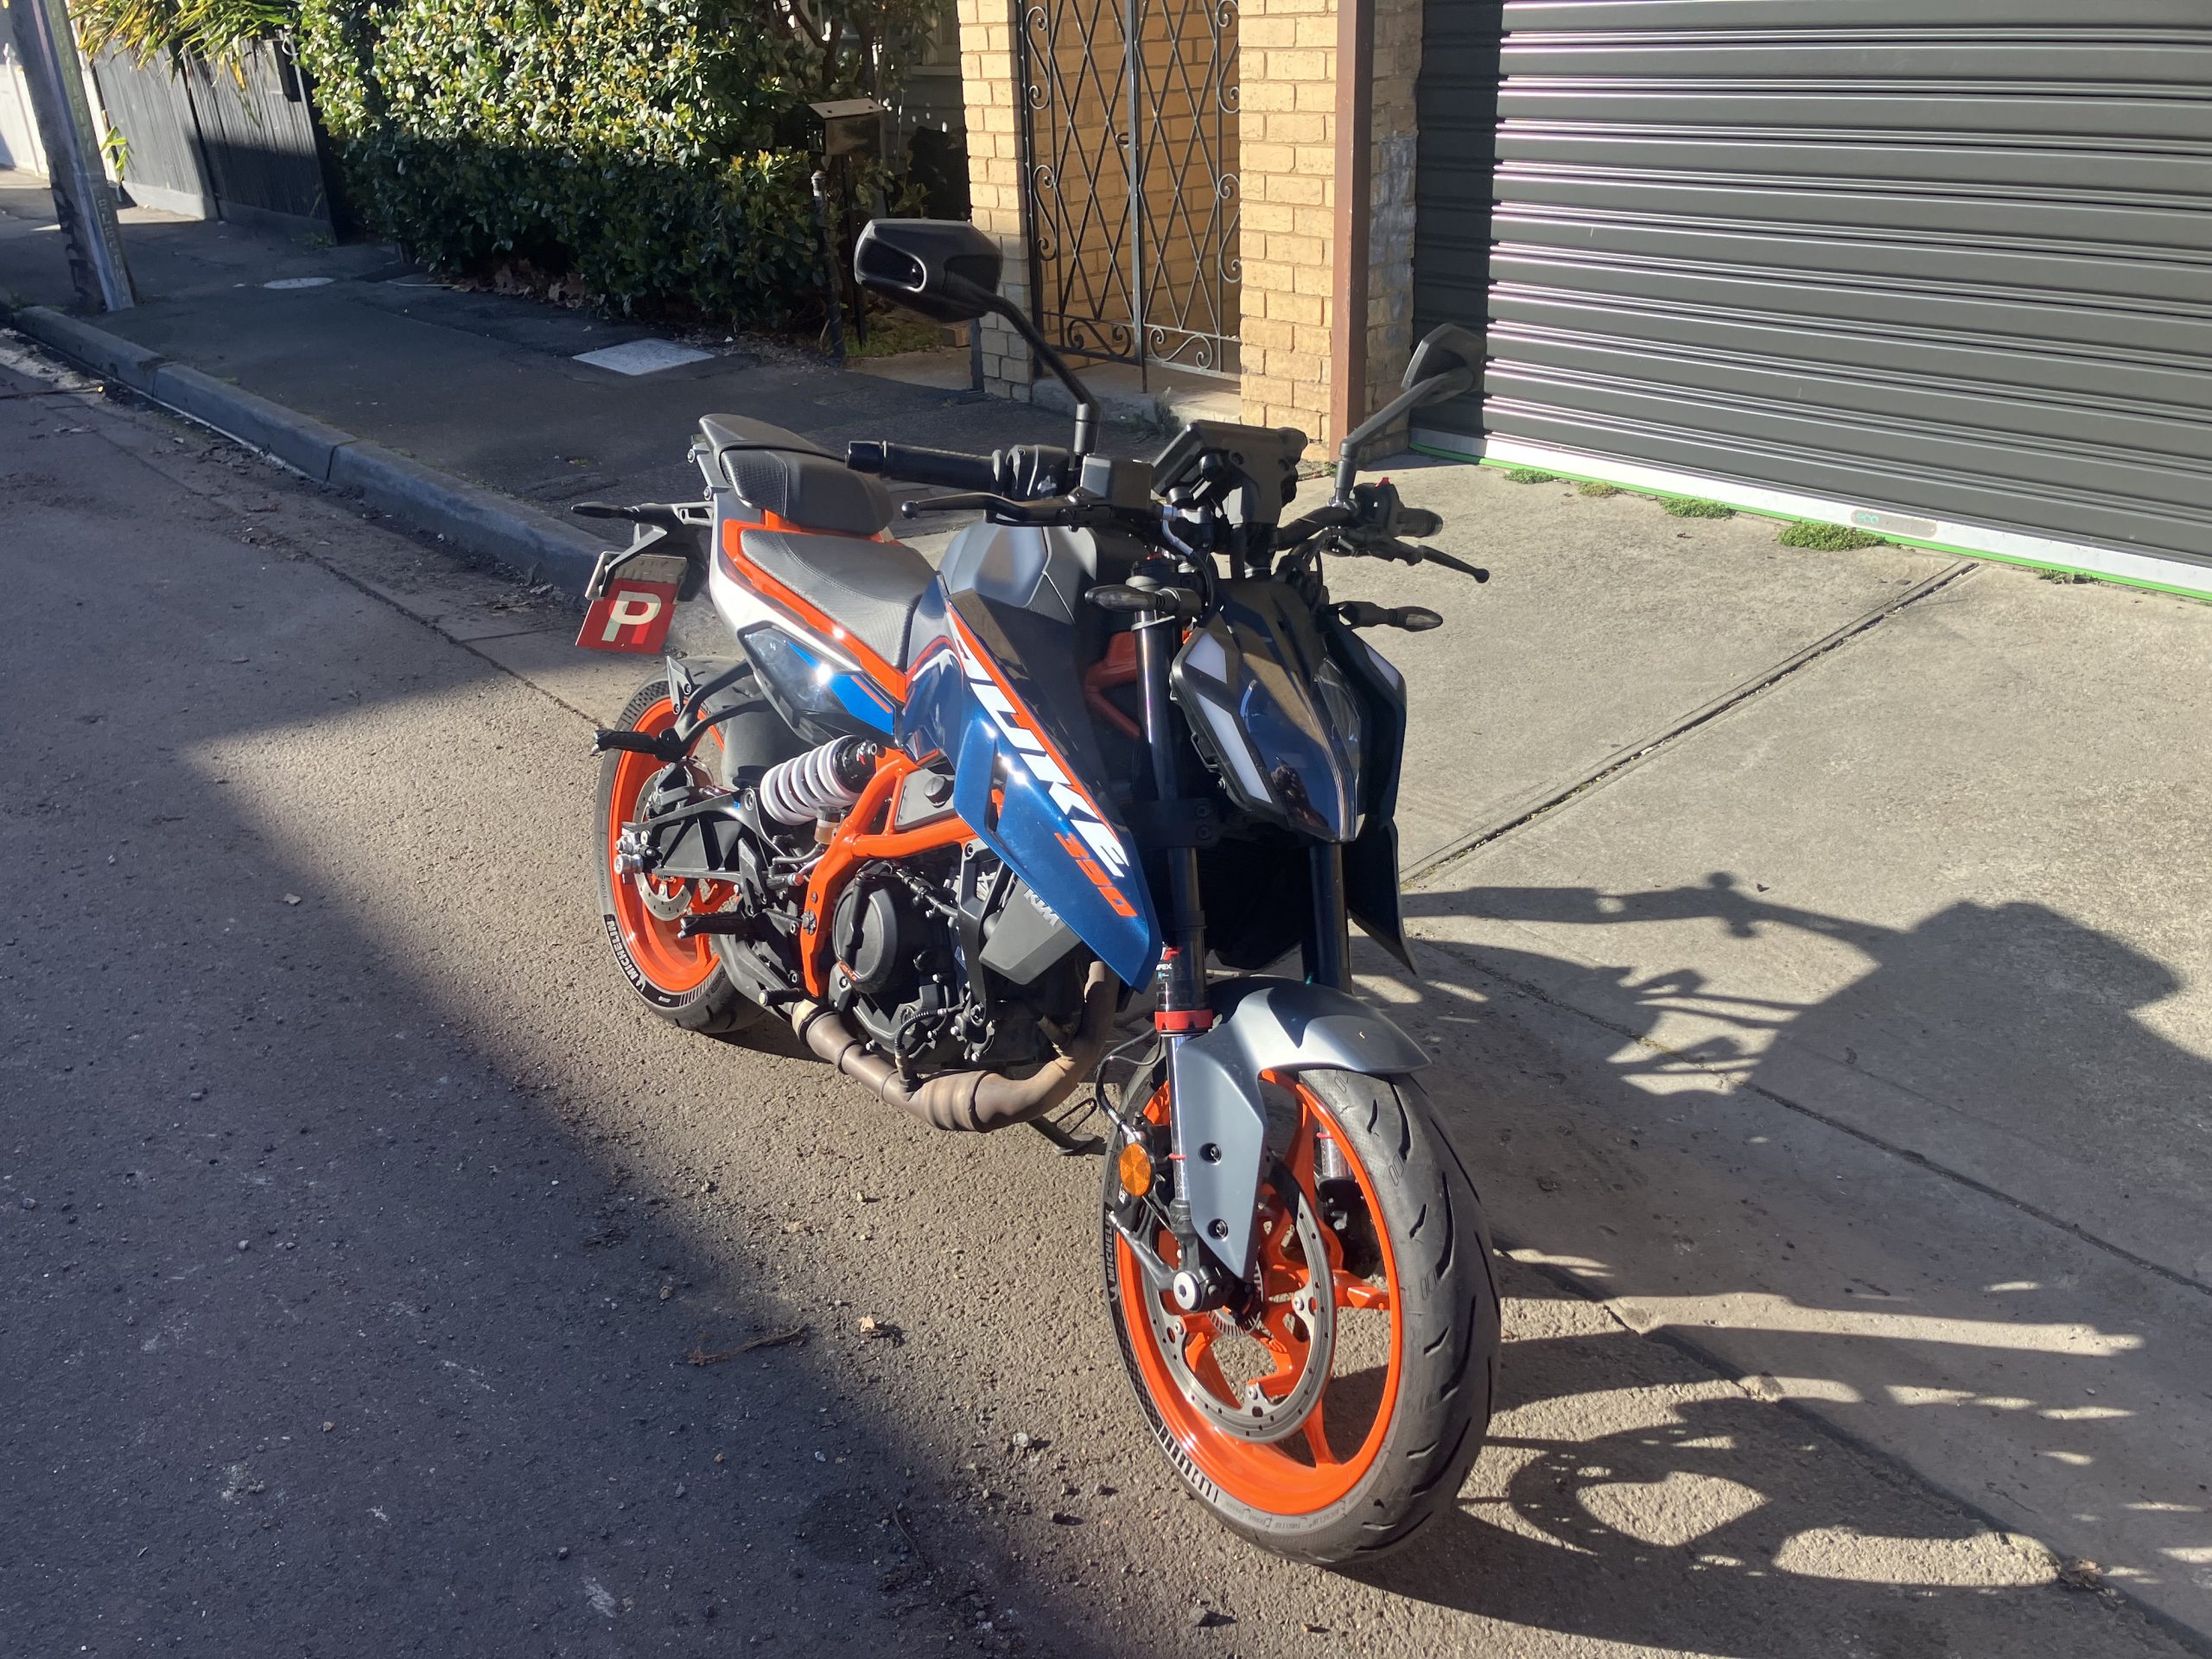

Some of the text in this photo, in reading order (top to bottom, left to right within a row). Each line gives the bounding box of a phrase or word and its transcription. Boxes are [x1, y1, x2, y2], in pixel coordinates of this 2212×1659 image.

[601, 590, 662, 642] P
[946, 612, 1129, 878] DUKE
[607, 920, 639, 981] MICHELIN
